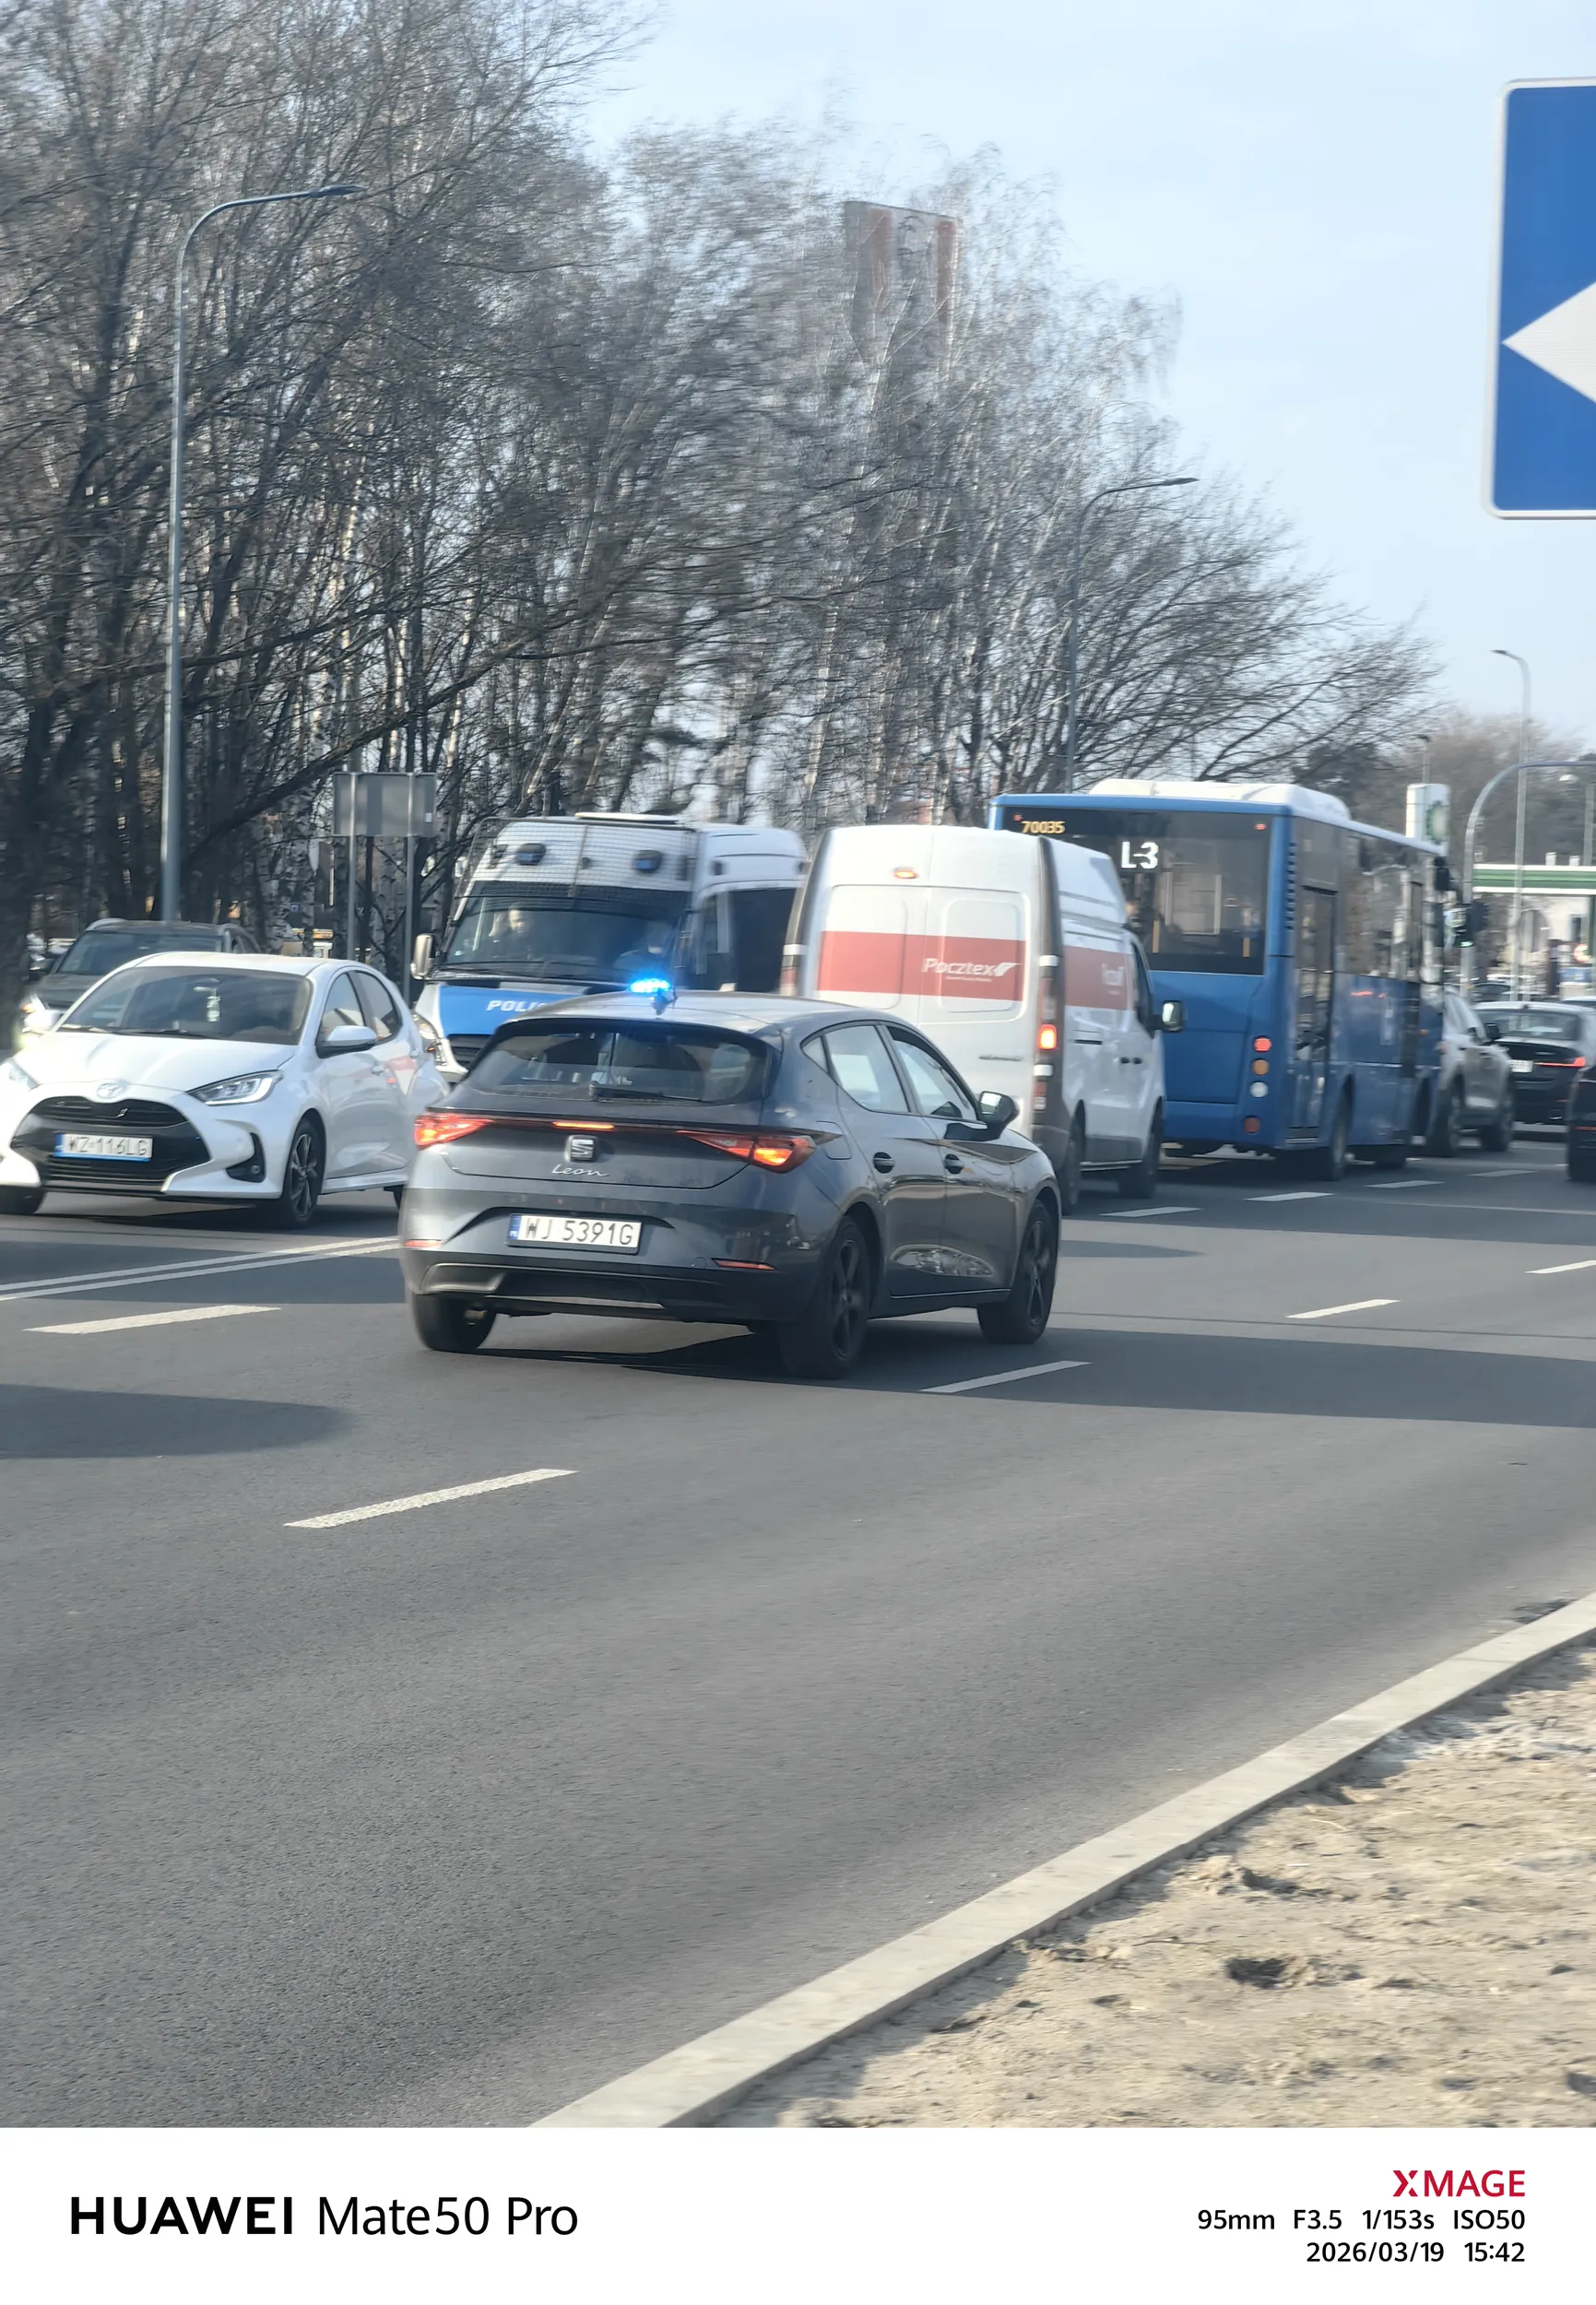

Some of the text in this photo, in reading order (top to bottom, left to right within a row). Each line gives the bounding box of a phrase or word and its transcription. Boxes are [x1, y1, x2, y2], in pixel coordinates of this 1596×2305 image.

[1022, 821, 1066, 834] 70035
[1121, 841, 1159, 869] L-3
[921, 958, 996, 976] Pocztex
[67, 1136, 148, 1155] WZ 116LG
[552, 1164, 610, 1177] Leon
[526, 1218, 634, 1246] WJ 5391G
